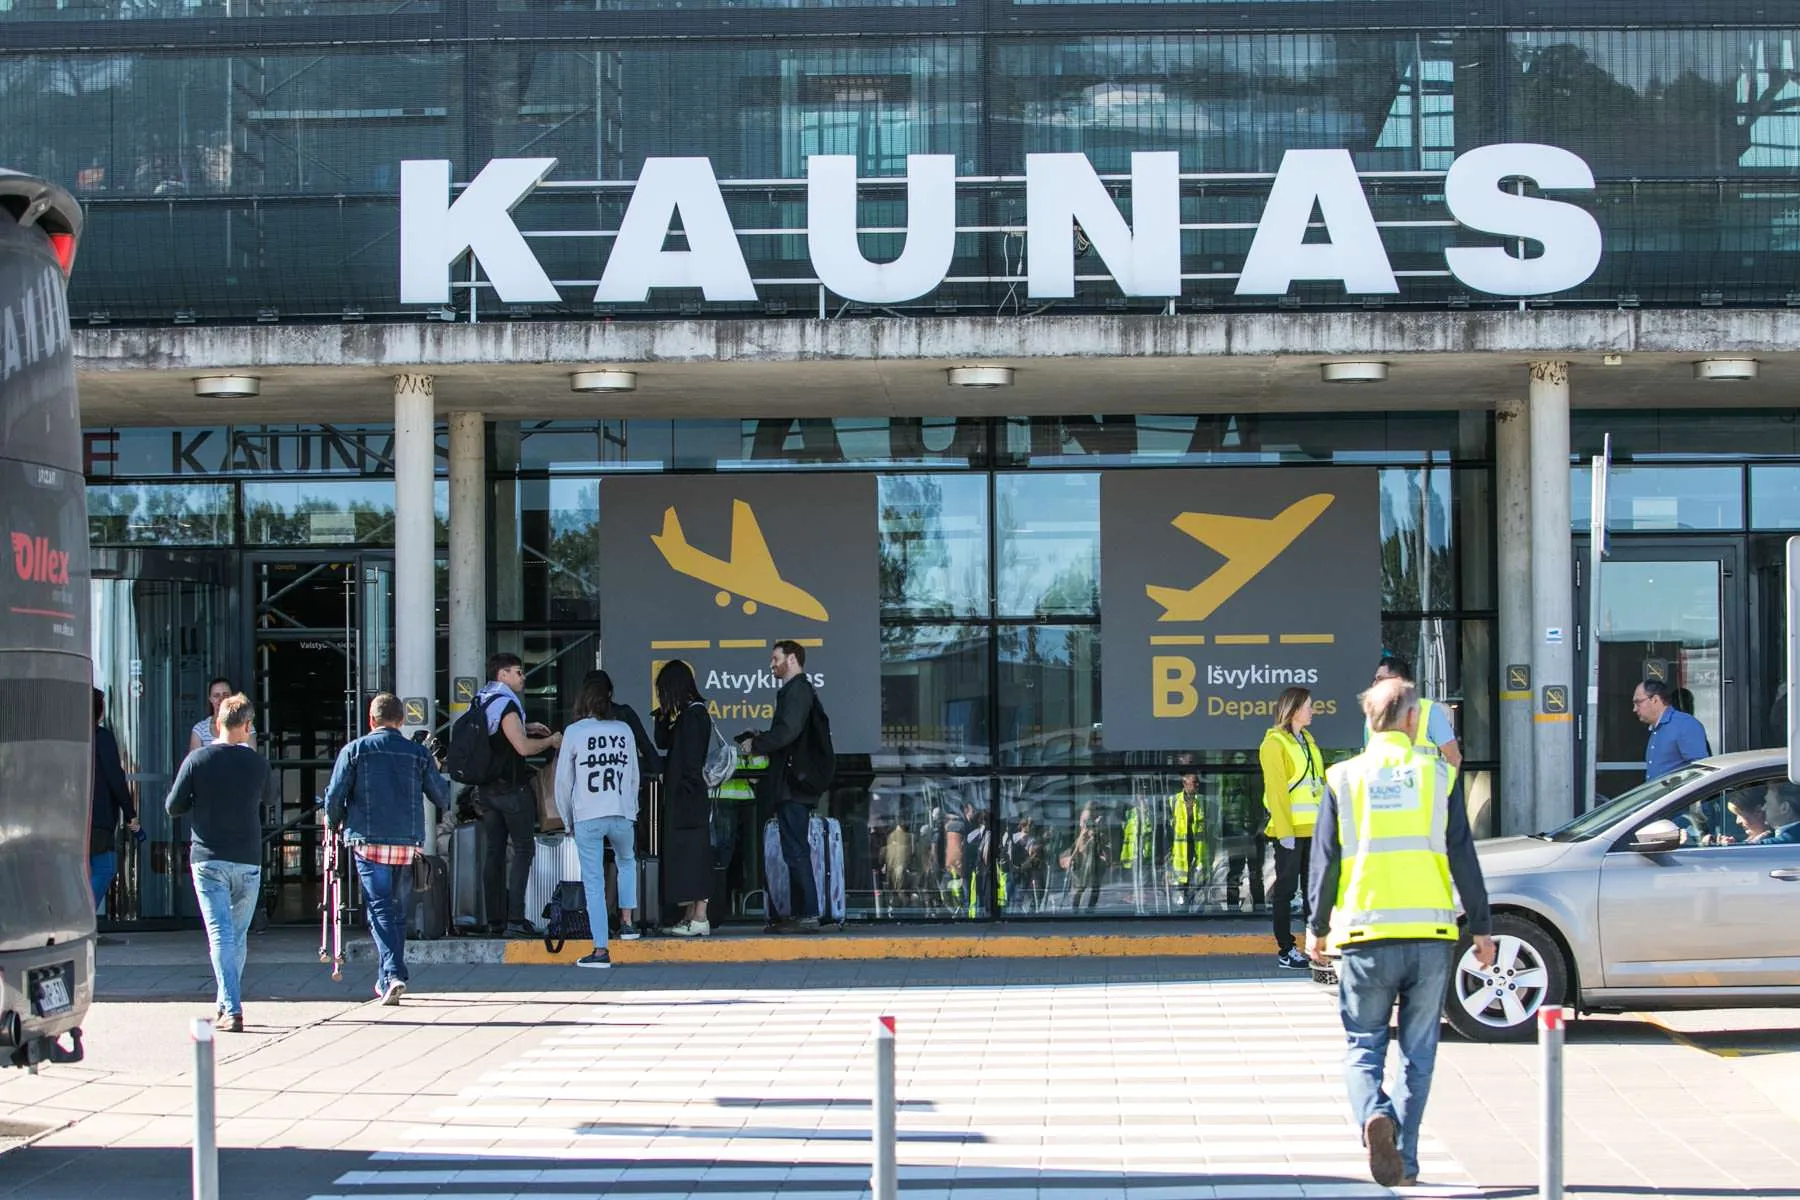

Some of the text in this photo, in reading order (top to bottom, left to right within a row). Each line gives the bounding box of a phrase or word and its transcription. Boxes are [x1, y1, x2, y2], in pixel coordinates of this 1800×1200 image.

[400, 142, 1602, 304] KAUNAS
[11, 531, 69, 584] Ollex
[705, 669, 825, 694] Atvykis
[1152, 656, 1199, 718] B
[1207, 664, 1319, 690] Išvykimas
[707, 700, 776, 720] Arriva
[1207, 696, 1337, 721] Depares
[588, 735, 626, 751] BOYS
[588, 767, 624, 796] CRY
